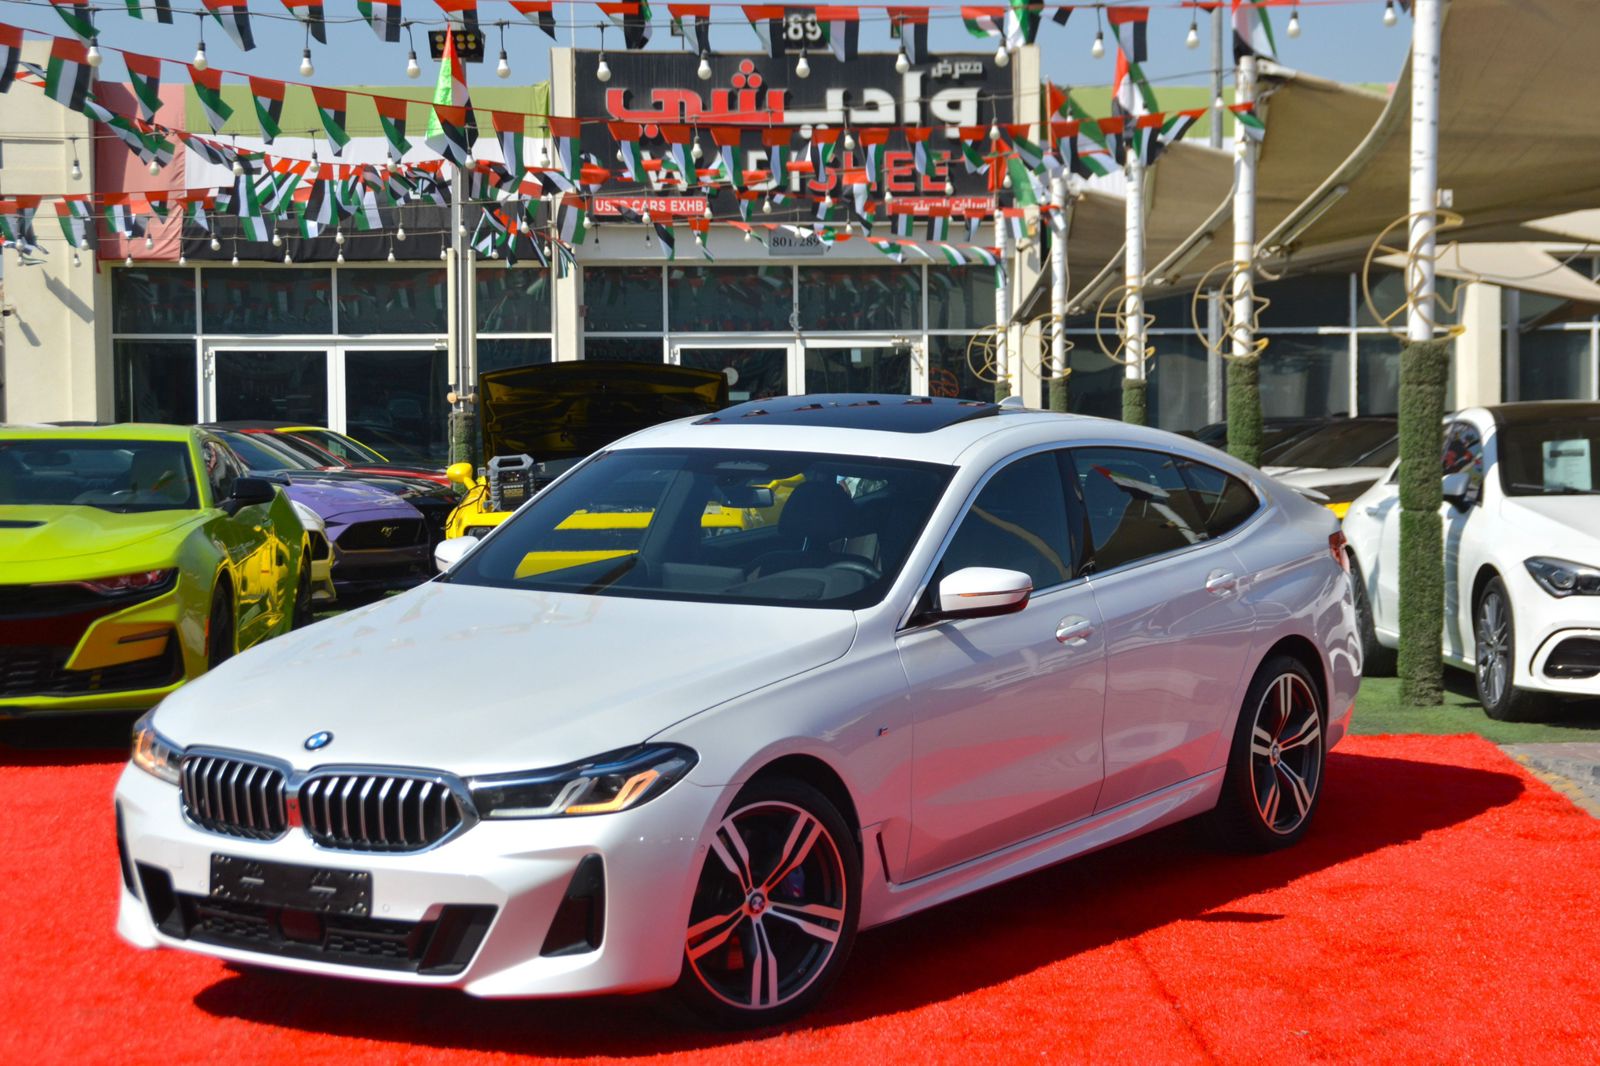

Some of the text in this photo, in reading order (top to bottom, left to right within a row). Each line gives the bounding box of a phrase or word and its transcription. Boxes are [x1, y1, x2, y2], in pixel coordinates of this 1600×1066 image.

[783, 13, 822, 40] 89
[931, 59, 983, 79] معرض
[631, 199, 666, 212] CARS
[670, 199, 704, 212] EXHB
